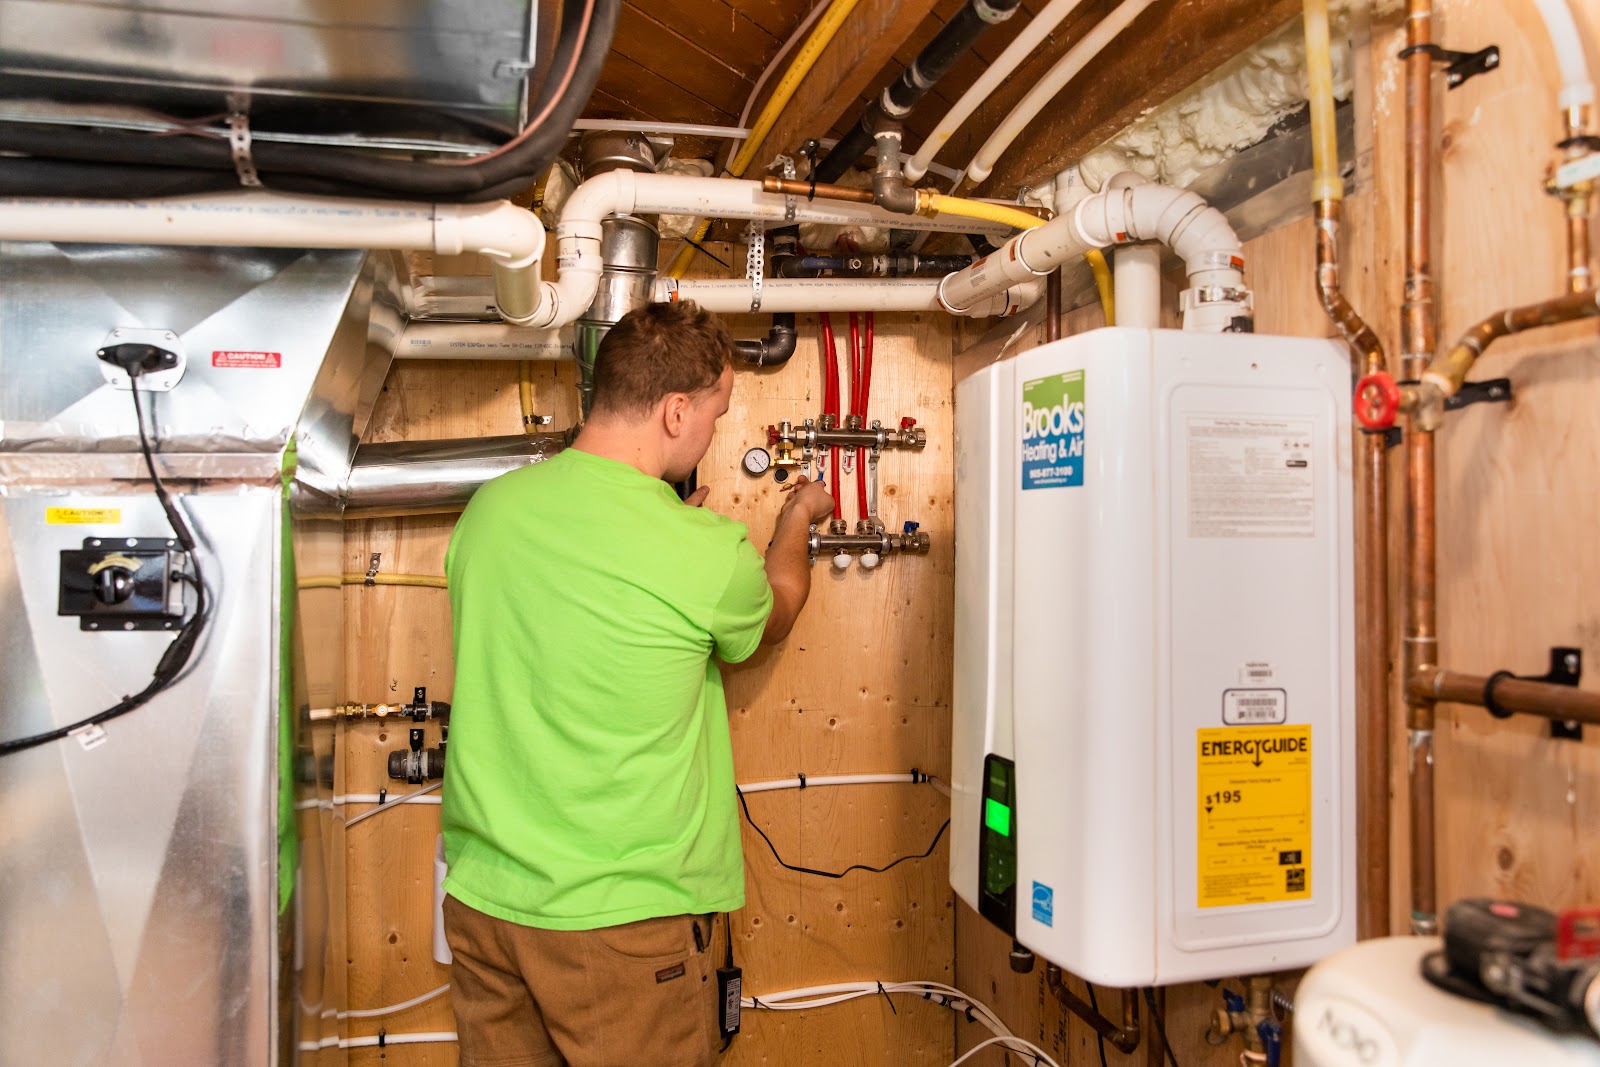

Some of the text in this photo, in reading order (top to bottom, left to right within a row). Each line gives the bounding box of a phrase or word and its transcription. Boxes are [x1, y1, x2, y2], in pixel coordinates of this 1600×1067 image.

[1023, 394, 1084, 440] Brooks
[1022, 436, 1084, 463] Heating & Air
[1201, 737, 1307, 757] ENERGYGUIDE
[1206, 790, 1242, 804] $195
